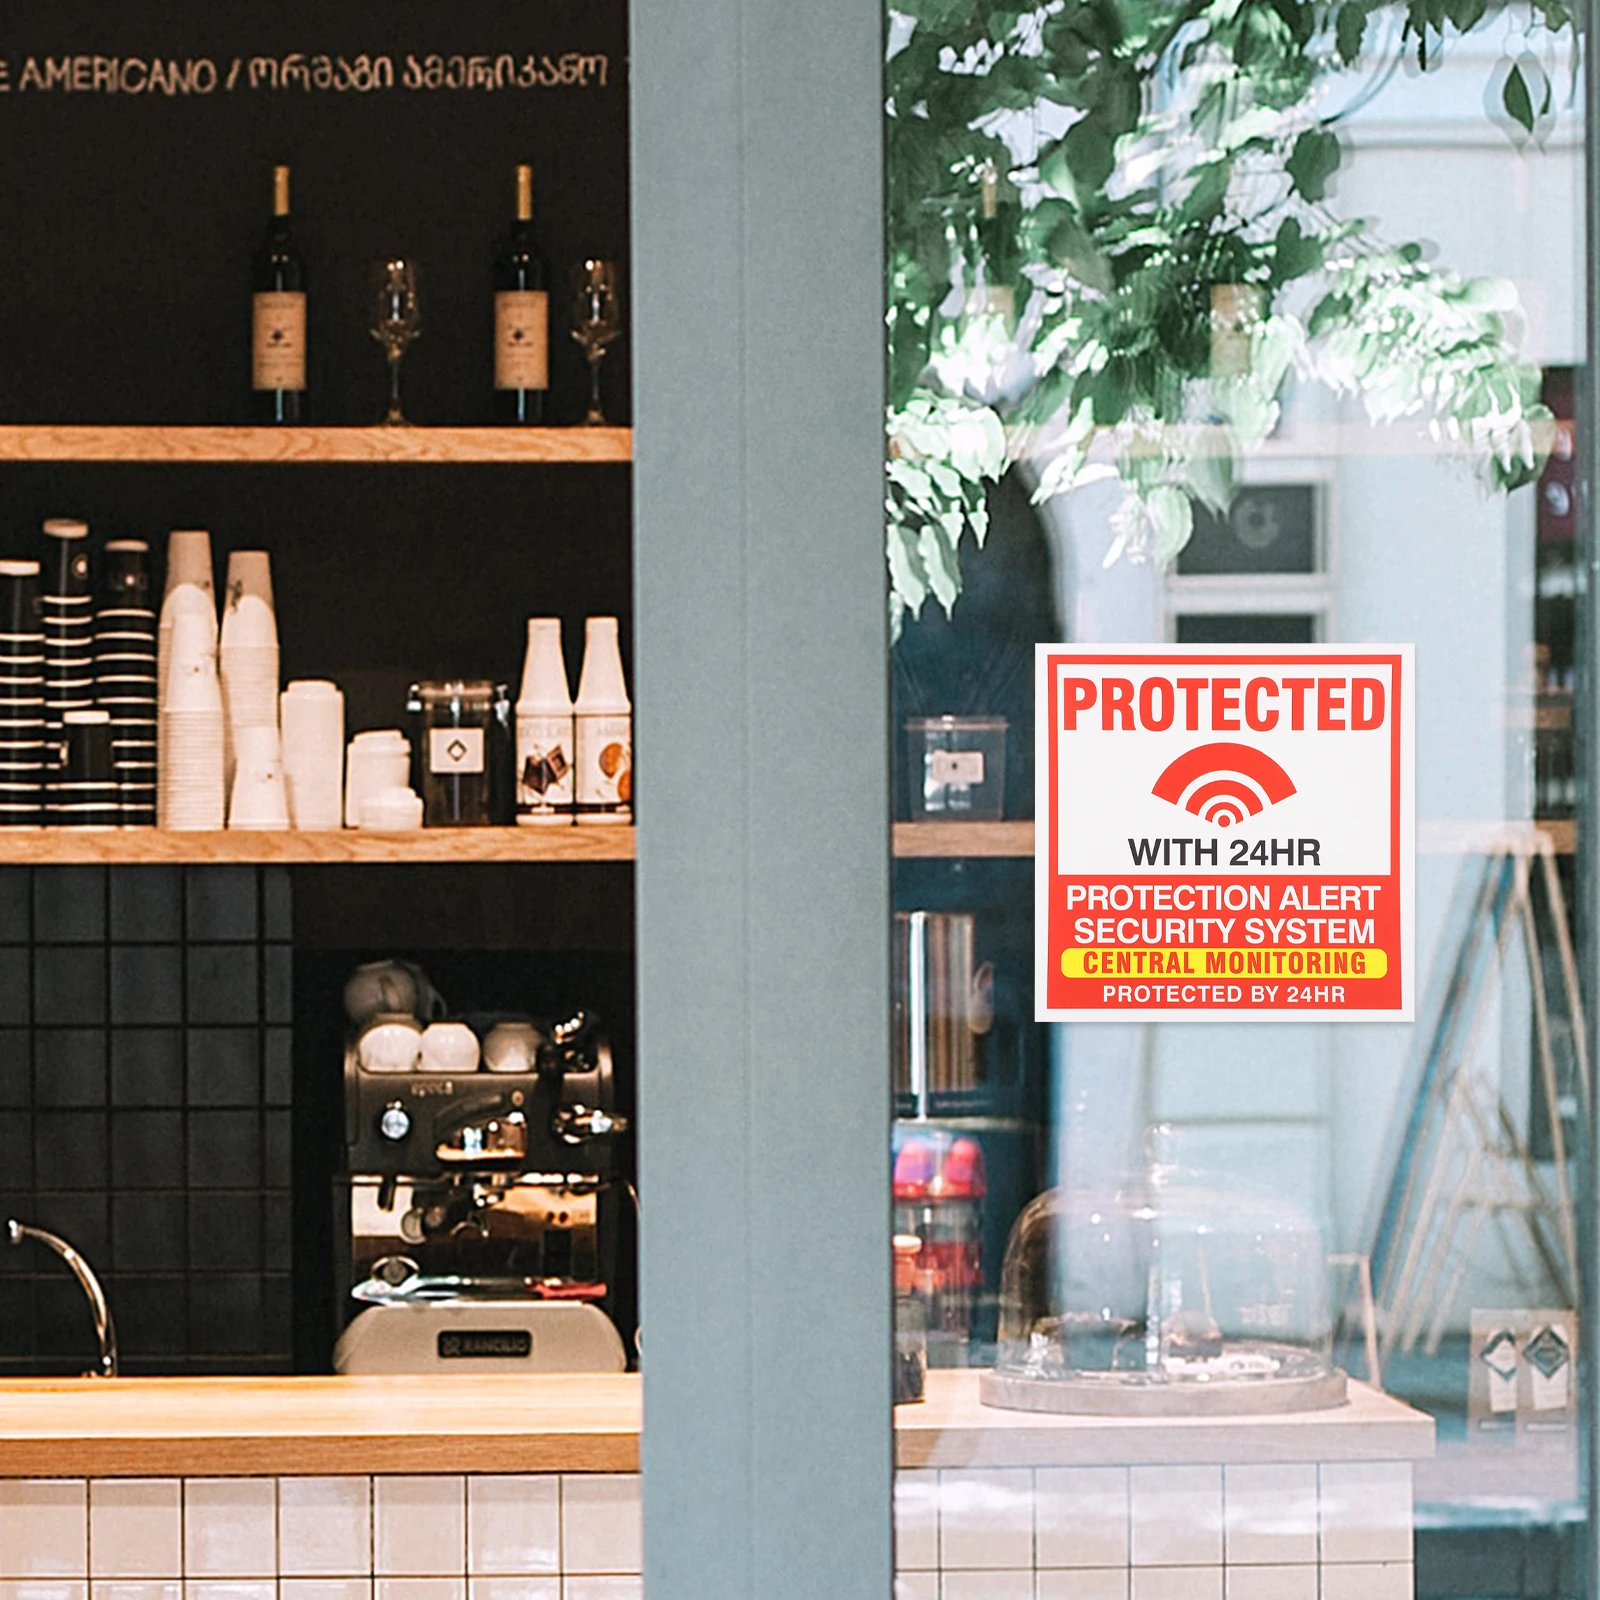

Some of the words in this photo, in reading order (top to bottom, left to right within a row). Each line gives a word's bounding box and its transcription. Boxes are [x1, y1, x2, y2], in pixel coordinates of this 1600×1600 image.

[19, 55, 217, 95] AMERICANO
[1063, 676, 1385, 732] PROTECTED
[1127, 838, 1218, 866] WITH
[1229, 838, 1321, 866] 24HR
[1066, 885, 1270, 911] PROTECTION
[1279, 885, 1382, 911] ALERT
[1074, 917, 1236, 944] SECURITY
[1244, 917, 1375, 944] SYSTEM
[1083, 951, 1195, 975] CENTRAL
[1205, 951, 1366, 975] MONITORING
[1102, 985, 1242, 1003] PROTECTED
[1251, 985, 1279, 1003] BY
[1287, 985, 1346, 1003] 24HR
